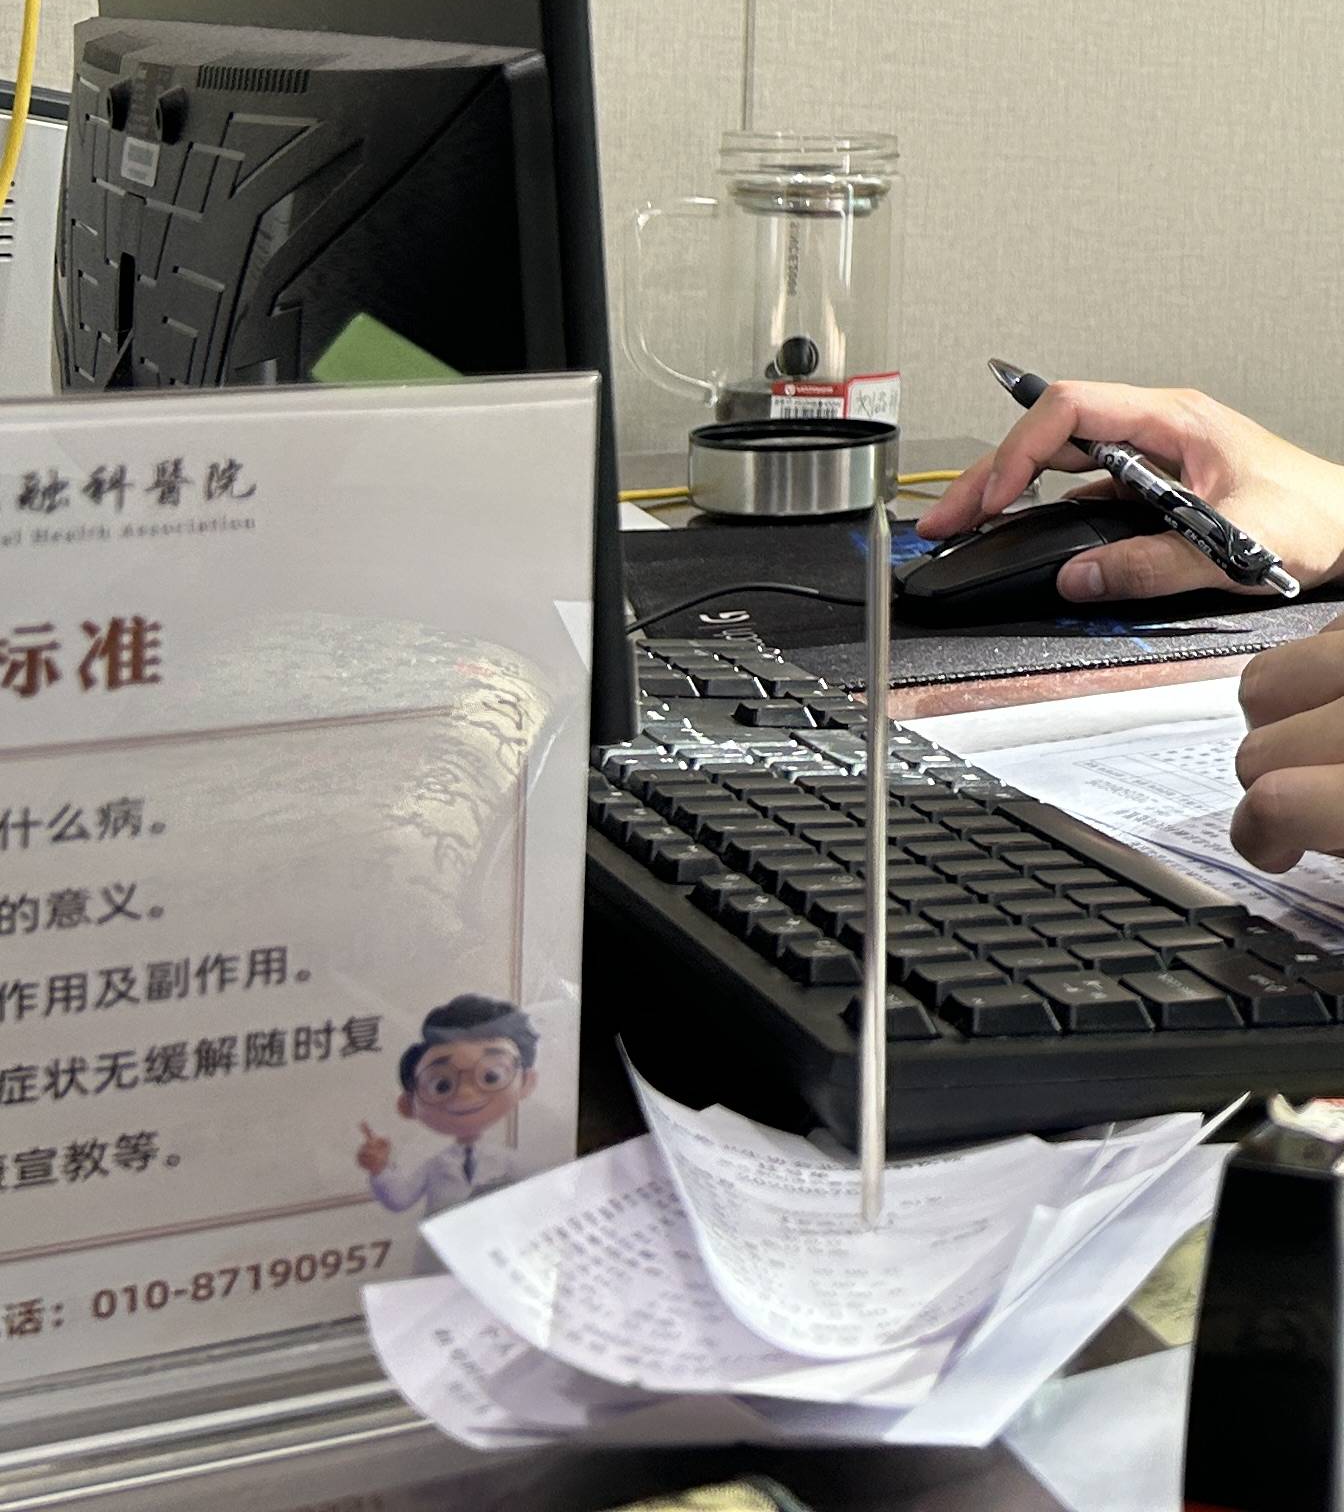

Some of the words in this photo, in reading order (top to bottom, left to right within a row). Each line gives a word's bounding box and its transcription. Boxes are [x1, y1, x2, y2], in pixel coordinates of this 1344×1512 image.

[0, 881, 165, 935] 的意义。
[0, 945, 312, 1023] 作用及副作用。
[0, 1014, 383, 1108] 症状无缓解随时复
[0, 1130, 181, 1190] 宣教等。
